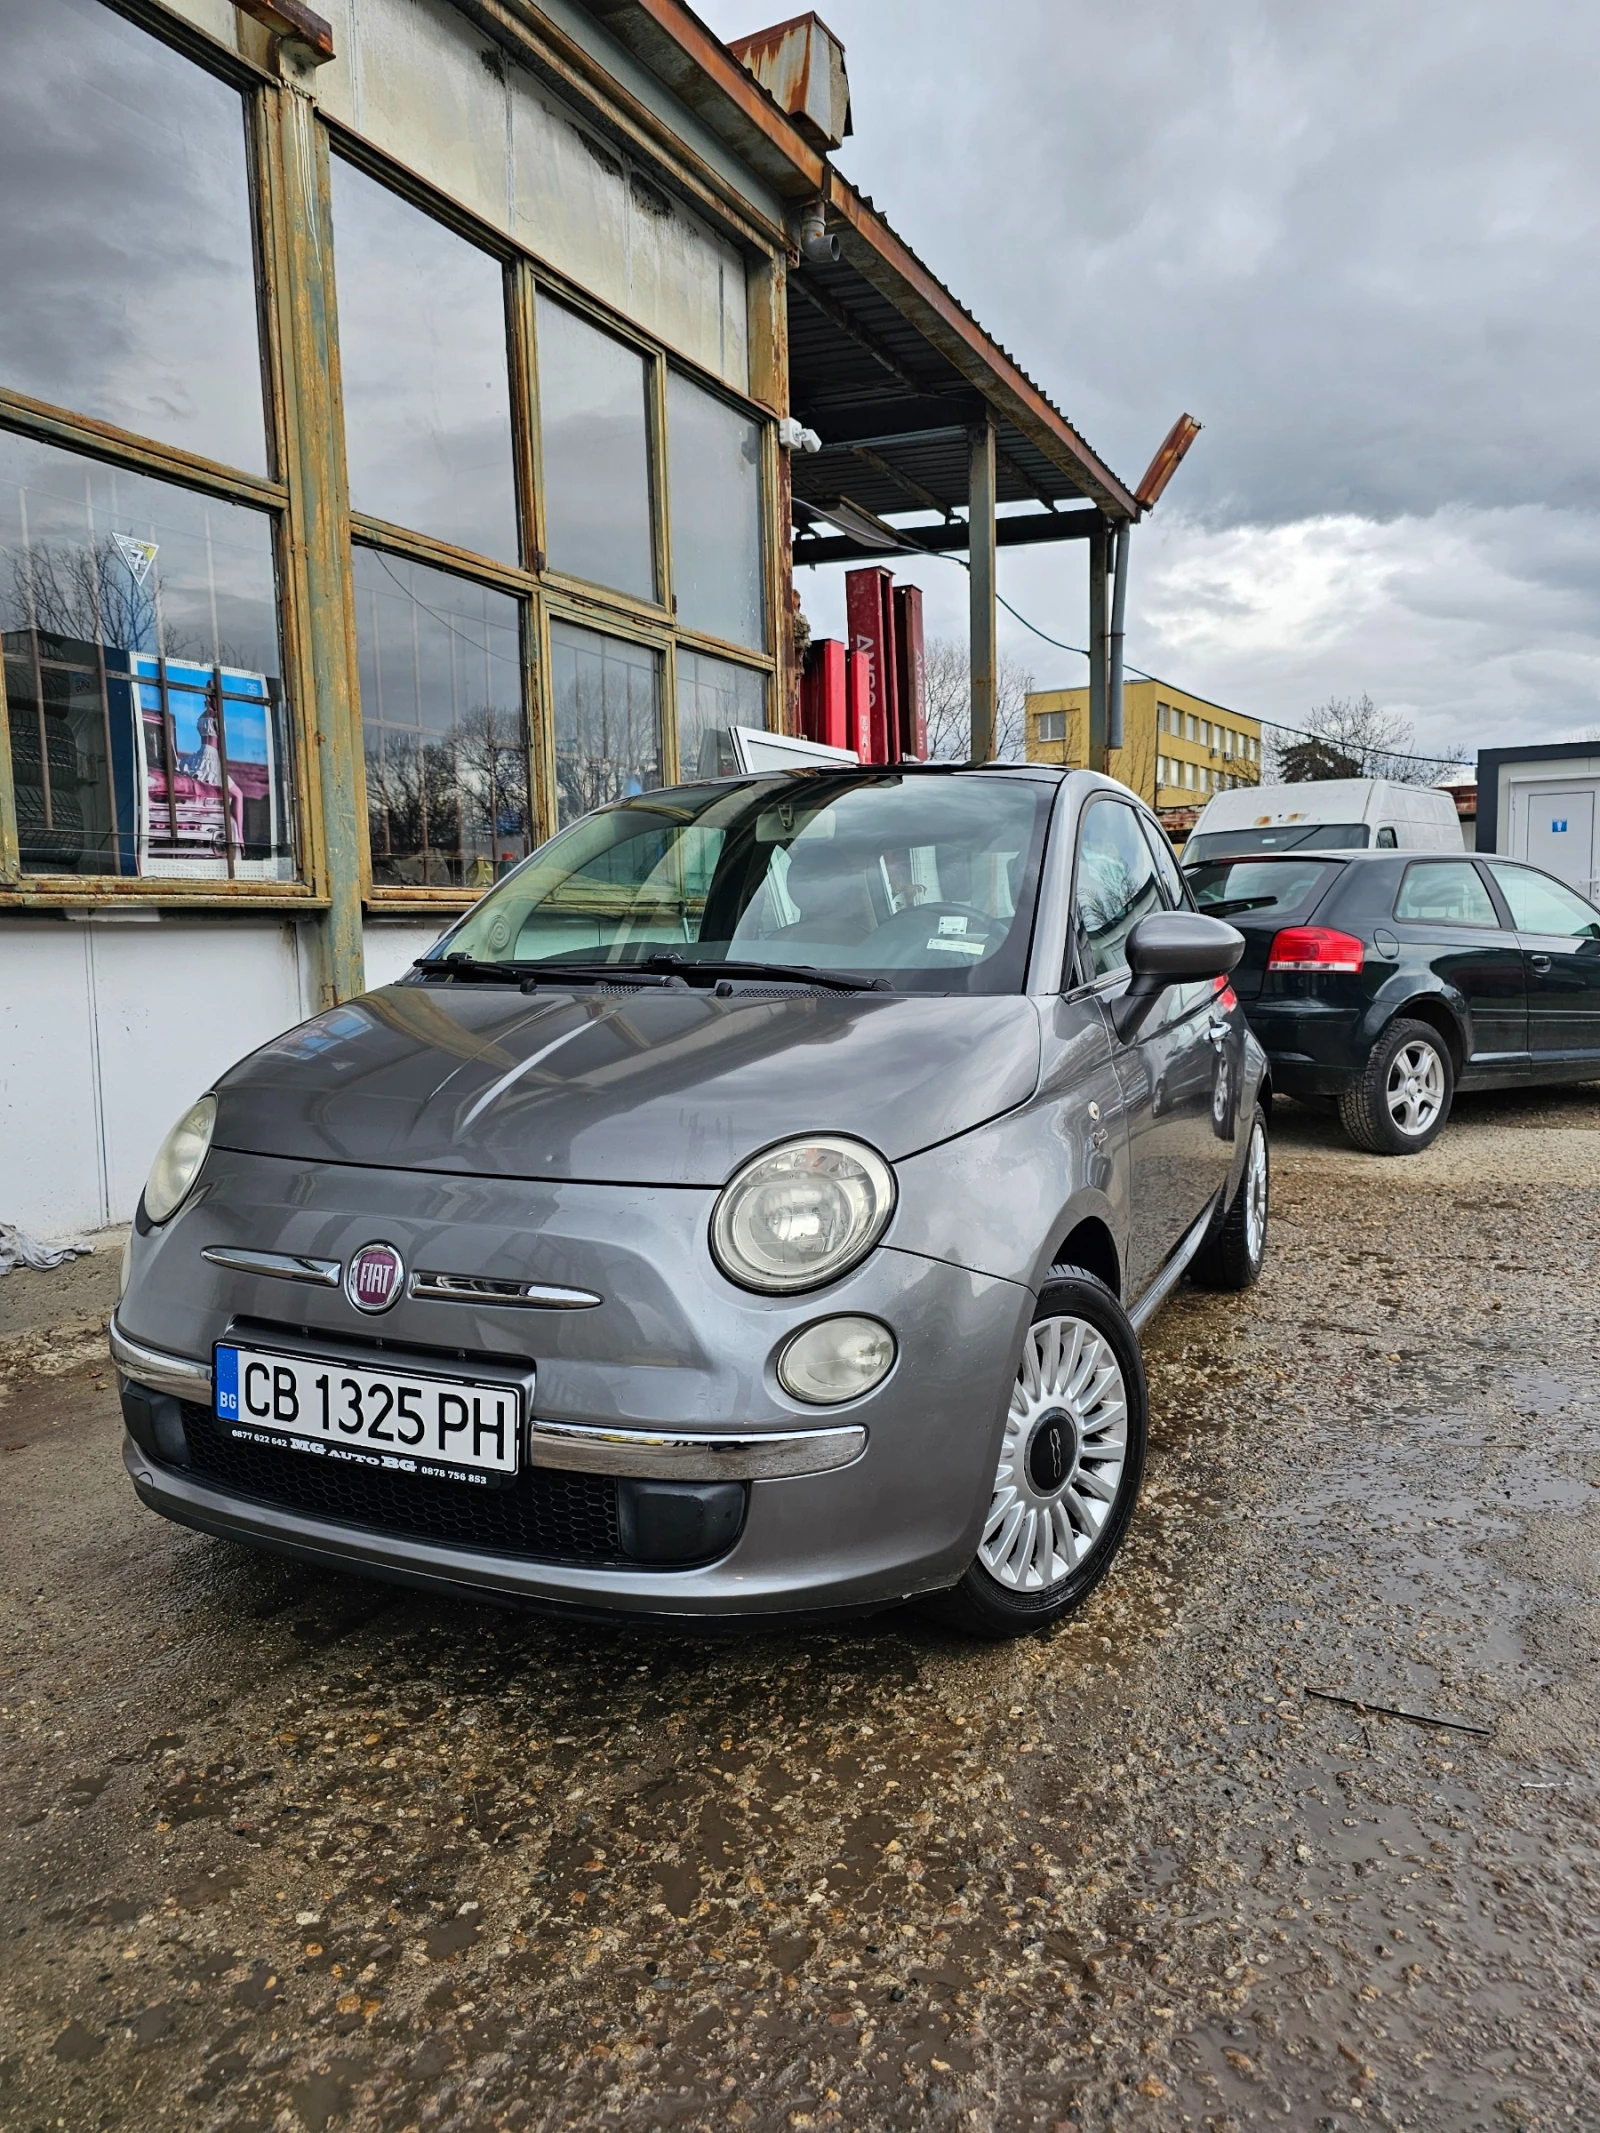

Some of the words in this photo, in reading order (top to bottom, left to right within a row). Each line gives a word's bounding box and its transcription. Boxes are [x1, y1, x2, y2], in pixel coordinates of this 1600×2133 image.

[916, 651, 925, 720] AMGO
[359, 1262, 394, 1294] FIAT
[220, 1391, 237, 1409] BG
[245, 1362, 299, 1422] CB
[316, 1374, 425, 1445] 1325
[438, 1392, 505, 1460] PH
[254, 1433, 270, 1444] 622
[289, 1438, 326, 1455] MG
[328, 1449, 380, 1466] AUTO
[381, 1455, 417, 1472] BG
[421, 1466, 446, 1477] 0878
[447, 1470, 466, 1481] 756
[468, 1473, 487, 1485] 853
